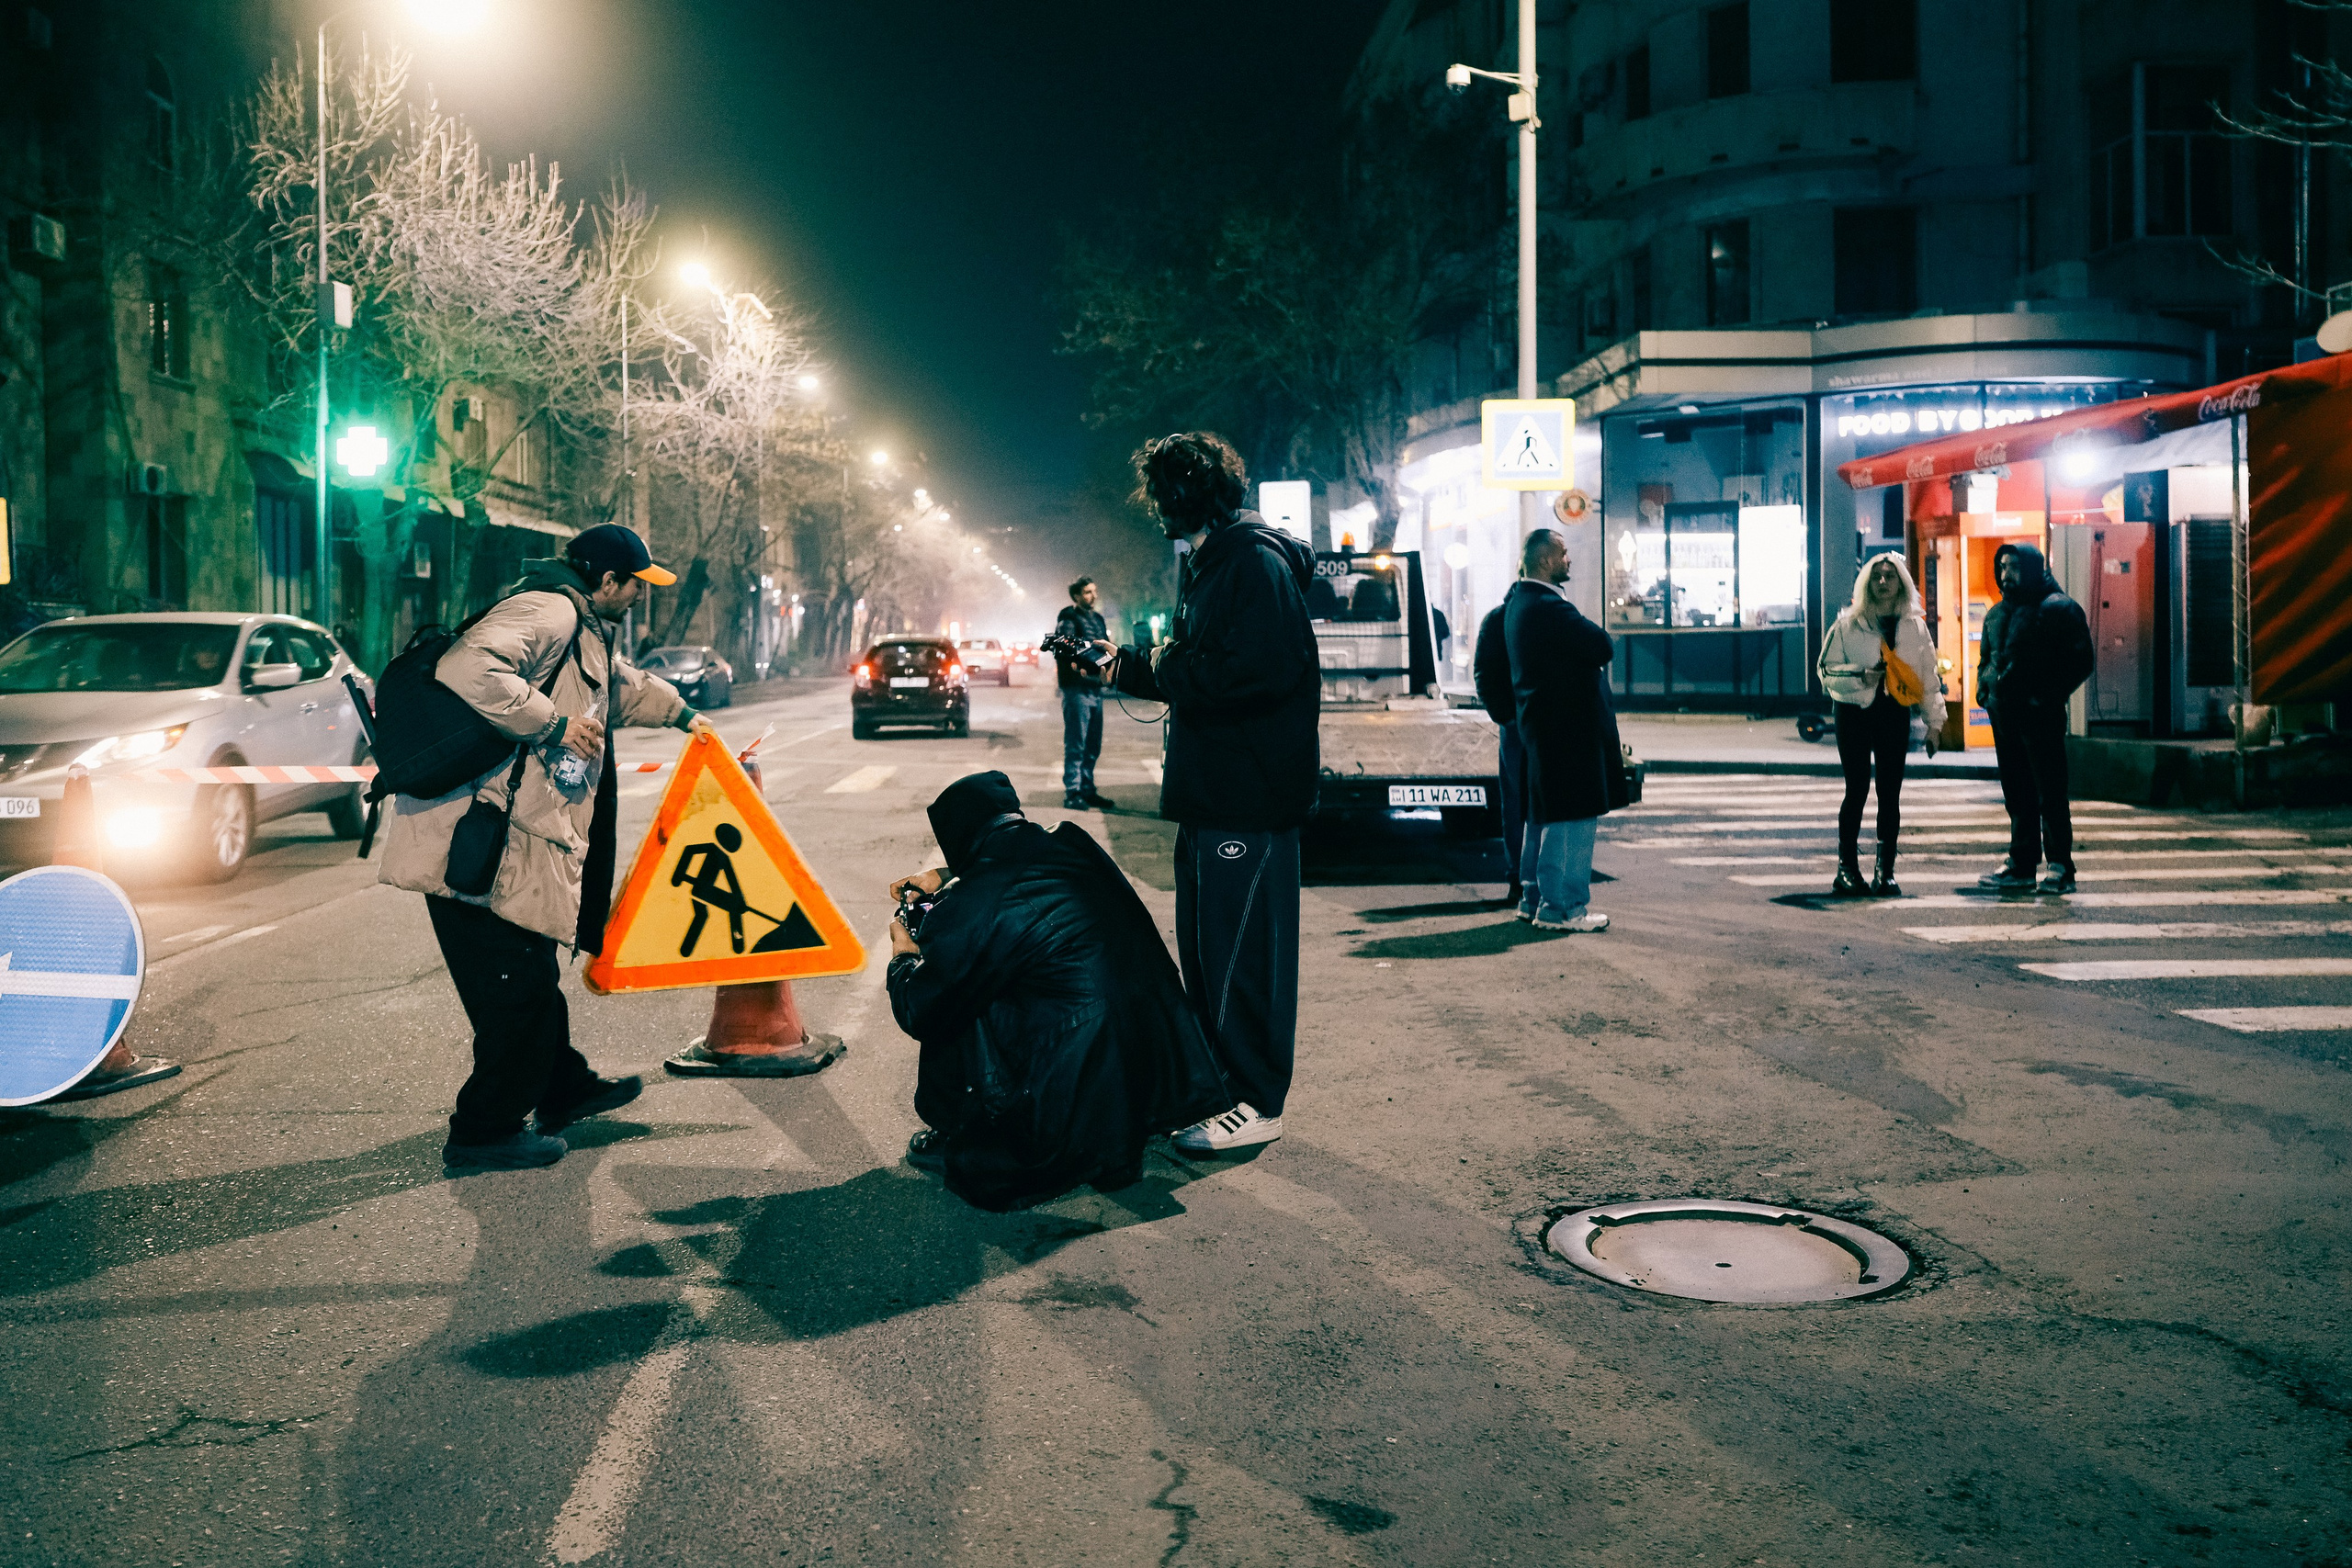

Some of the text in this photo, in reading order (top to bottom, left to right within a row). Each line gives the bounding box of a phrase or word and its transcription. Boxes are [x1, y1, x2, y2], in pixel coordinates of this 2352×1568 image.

[1838, 412, 1910, 436] FOOD
[1313, 560, 1348, 576] 509
[1408, 788, 1482, 802] 11 WA 211
[7, 799, 35, 814] 096
